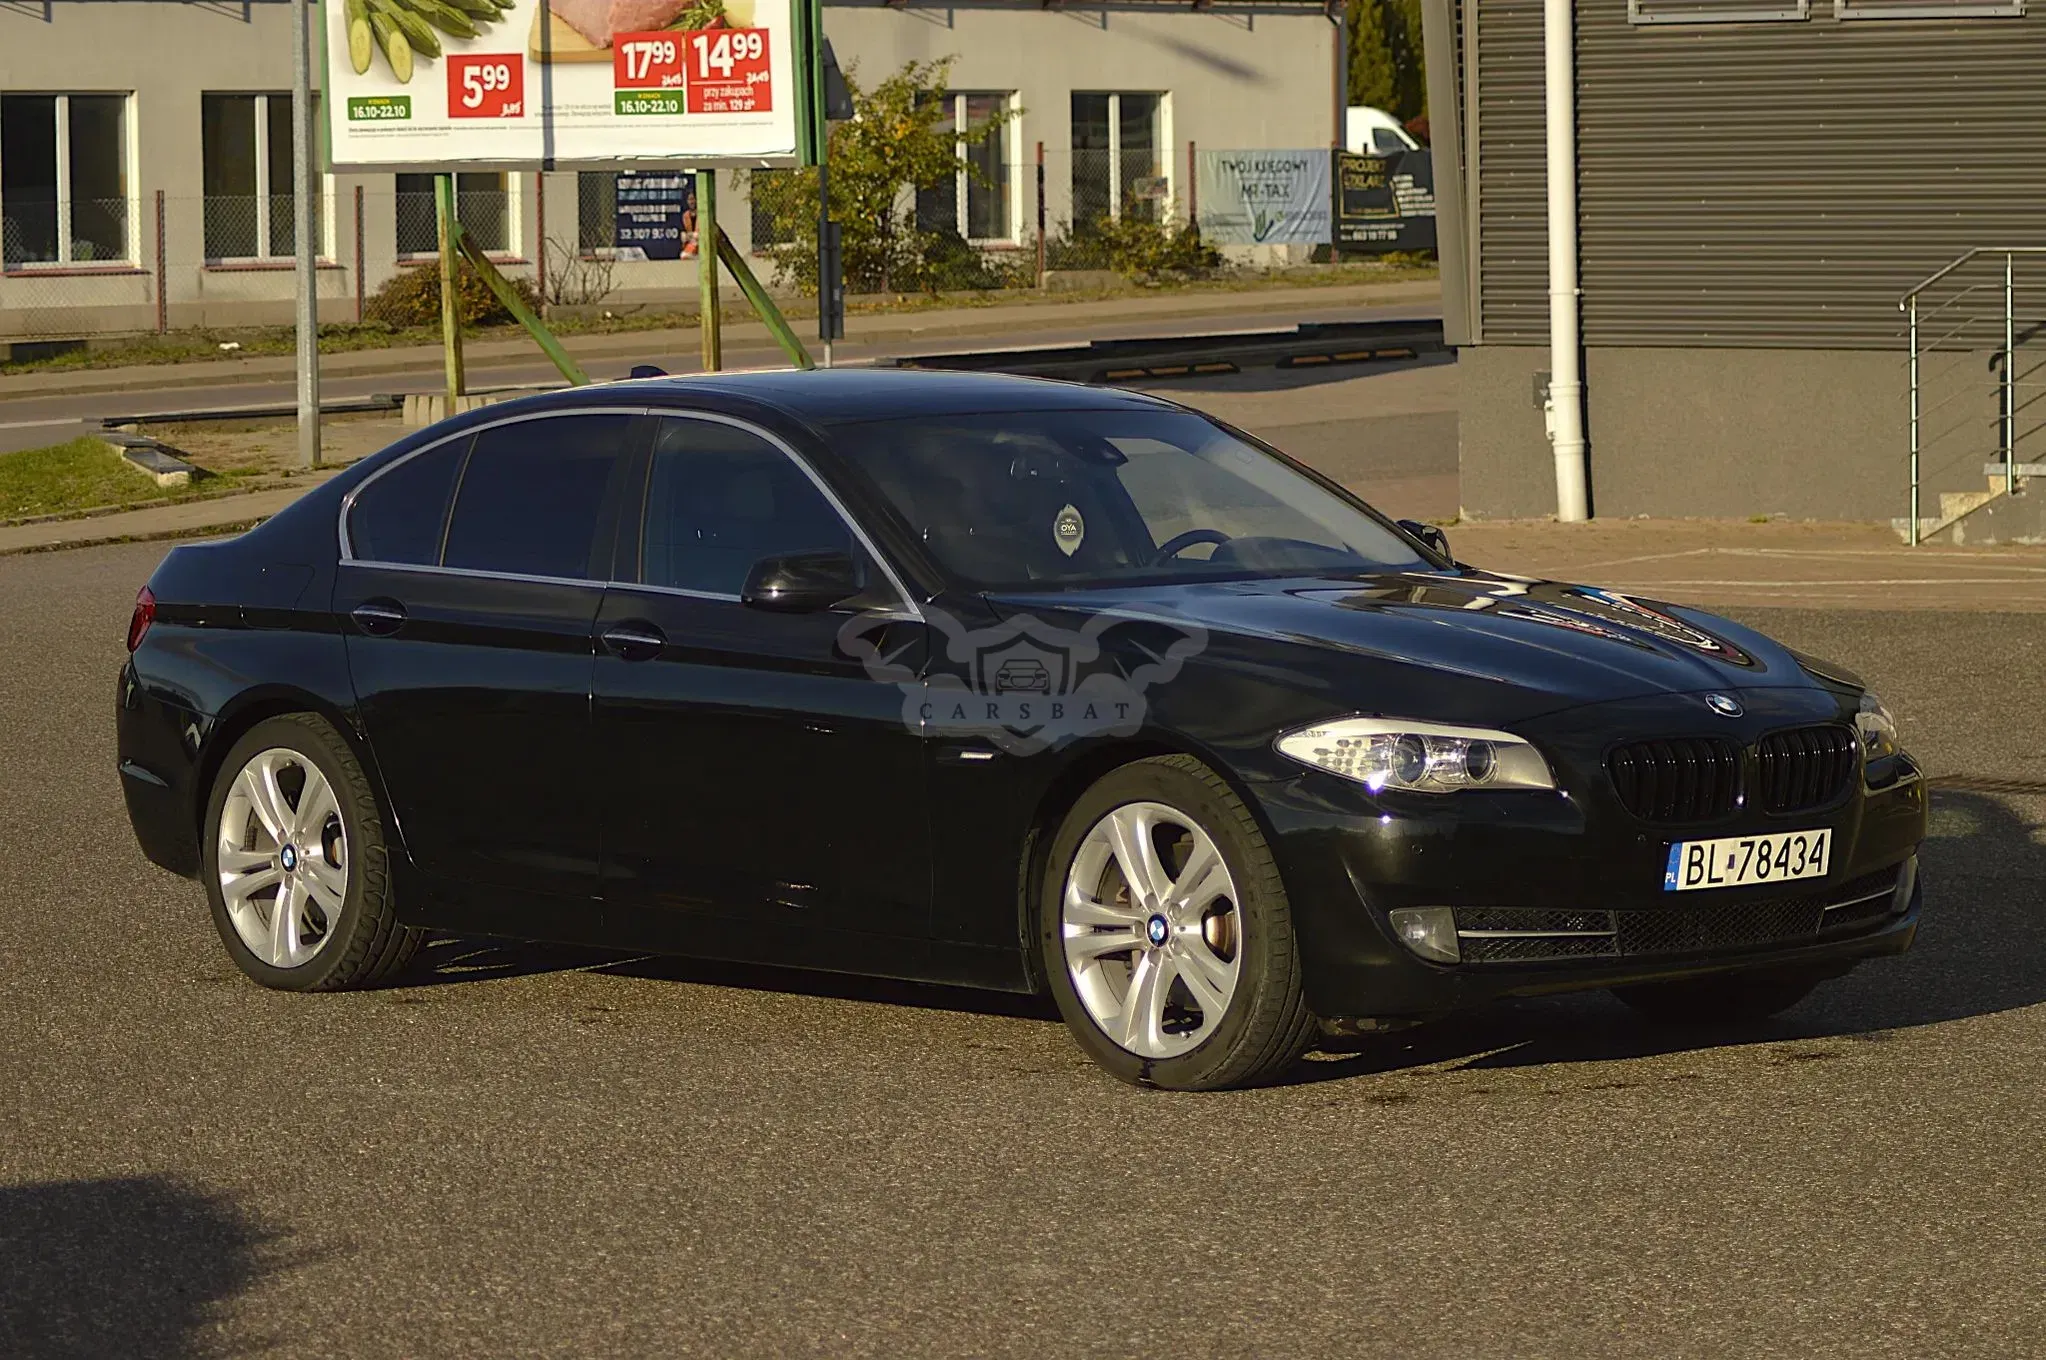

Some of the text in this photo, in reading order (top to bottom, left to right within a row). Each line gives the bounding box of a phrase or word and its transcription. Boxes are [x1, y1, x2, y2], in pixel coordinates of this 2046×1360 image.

[353, 105, 406, 119] 16.10-22.10
[620, 100, 678, 113] 16.10-22.10
[1664, 833, 1825, 886] PL BL 78434
